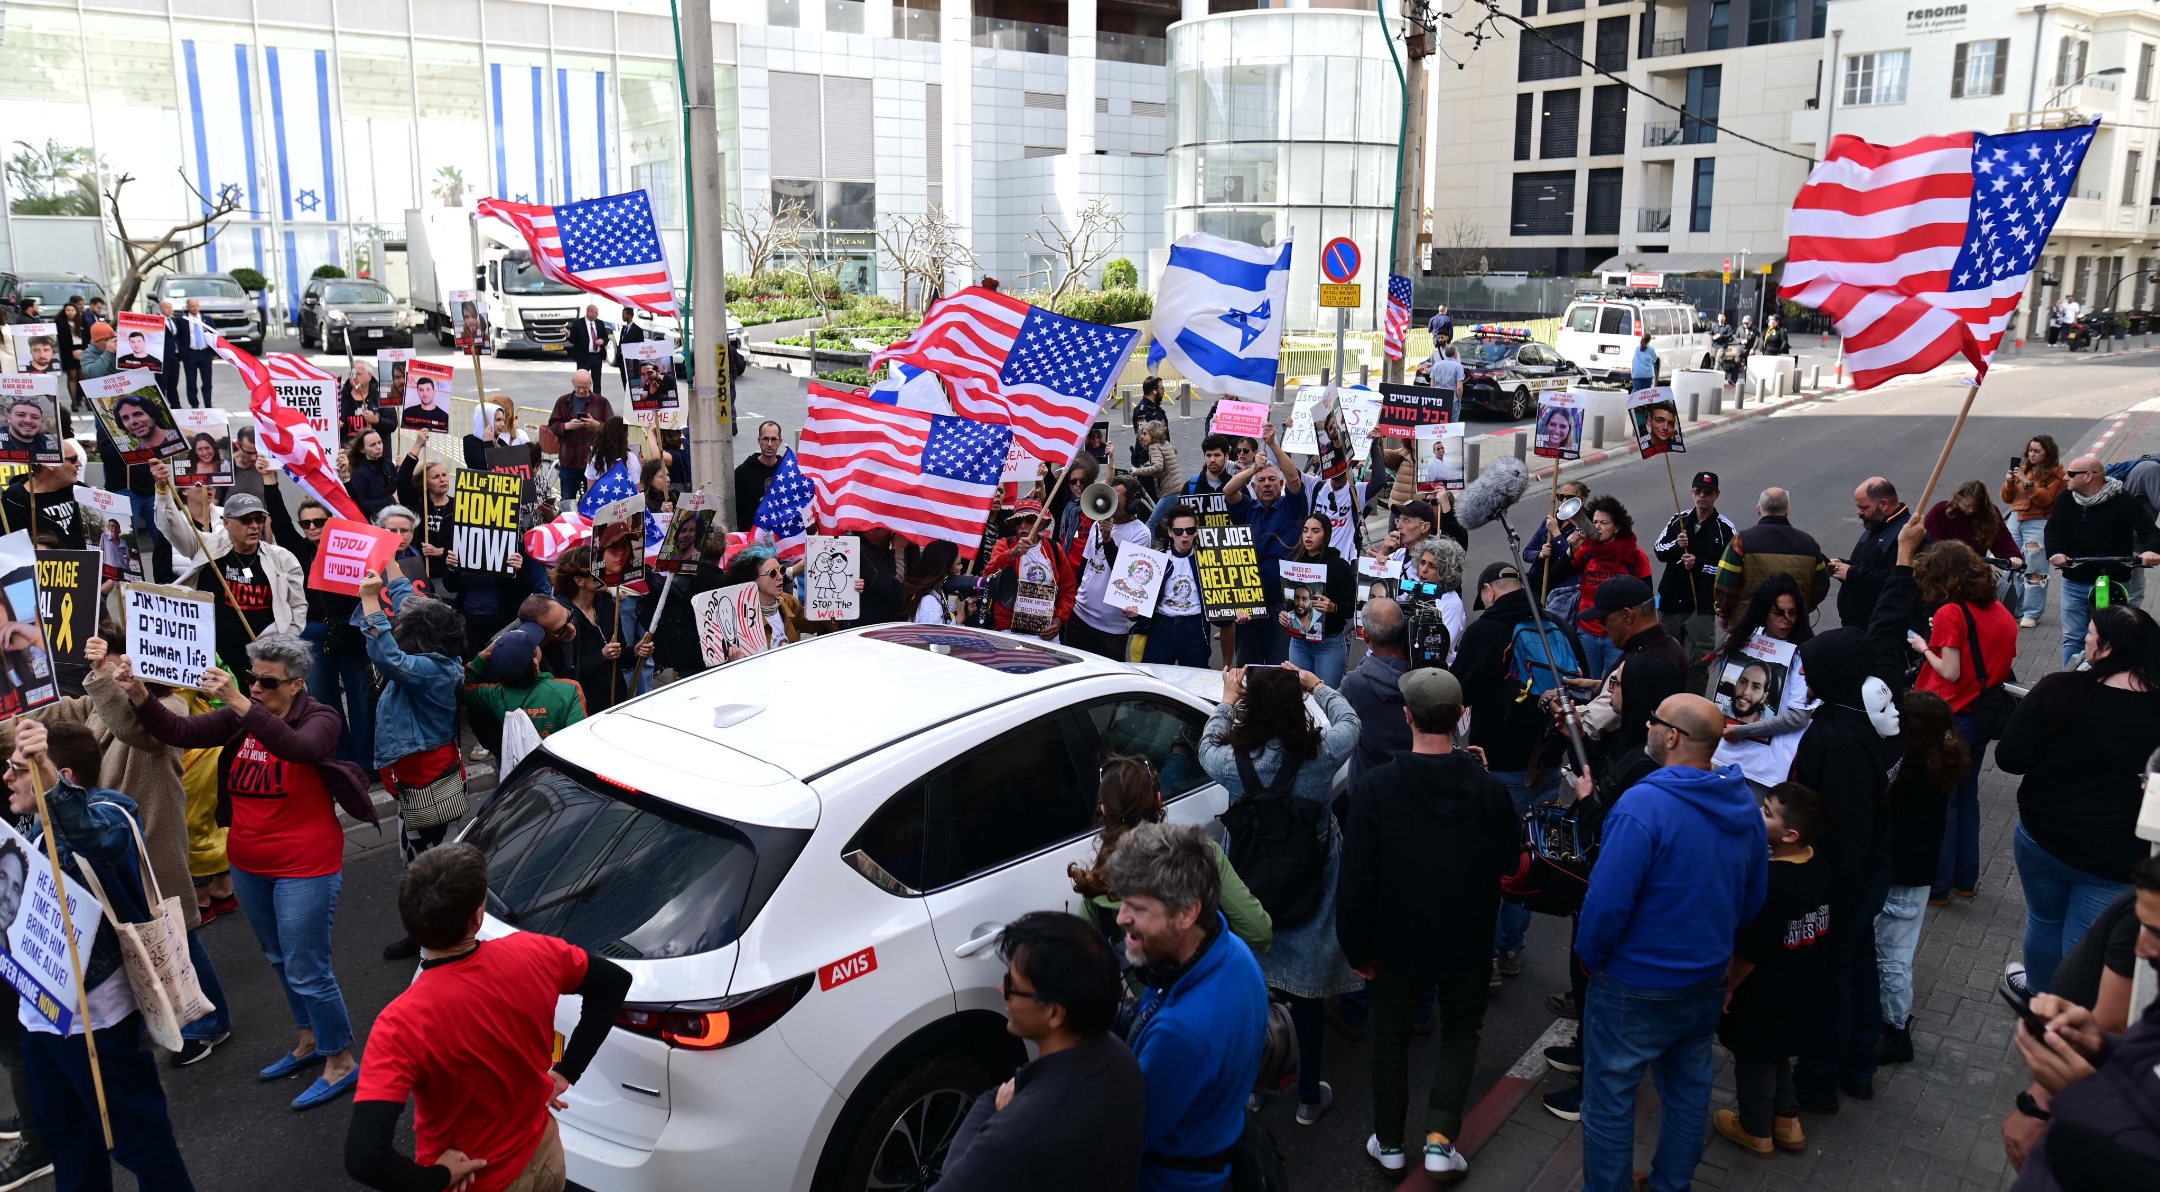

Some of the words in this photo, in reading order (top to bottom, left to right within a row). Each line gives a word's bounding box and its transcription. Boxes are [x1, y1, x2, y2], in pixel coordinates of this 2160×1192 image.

[1907, 4, 1967, 20] renoma
[1931, 18, 1966, 27] Apartments
[275, 386, 322, 395] BRING
[1296, 389, 1322, 402] Israe
[1341, 394, 1359, 404] ust
[1390, 393, 1419, 404] שבויים
[1421, 396, 1443, 407] פדיון
[296, 407, 321, 417] ME
[1382, 405, 1418, 421] מחיר
[1422, 407, 1449, 424] בכל
[1365, 418, 1373, 427] to
[174, 459, 191, 468] BRING
[1323, 461, 1332, 470] HIM
[457, 471, 479, 490] ALL
[479, 475, 487, 487] OF
[488, 474, 521, 495] THEM
[454, 491, 519, 528] HOME
[333, 535, 368, 551] עסקה
[1222, 527, 1253, 547] JOE!
[453, 524, 517, 574] NOW!
[1197, 549, 1220, 567] MR.
[1221, 548, 1257, 566] BIDEN
[328, 562, 360, 578] עכשיו!
[1200, 566, 1238, 588] HELP
[1240, 566, 1261, 587] US
[132, 592, 153, 610] את
[1204, 589, 1232, 604] SAVE
[1232, 587, 1265, 603] THEM!
[156, 595, 199, 619] החזירו
[812, 600, 833, 609] STOP
[1208, 609, 1217, 617] ALL
[1220, 608, 1235, 617] THEM
[1252, 606, 1267, 615] NOW!
[139, 614, 196, 641] החטופים
[140, 638, 182, 664] Human
[187, 646, 207, 668] life
[141, 661, 178, 680] comes
[524, 707, 547, 717] spa
[37, 870, 49, 892] HE
[48, 882, 61, 905] HA
[32, 891, 51, 919] TIME
[51, 907, 60, 929] TO
[25, 913, 49, 944] BRING
[48, 935, 65, 960] HIM
[21, 934, 43, 966] HOME
[42, 954, 68, 989] ALIVE!
[831, 954, 869, 984] AVIS
[16, 973, 38, 1005] HOME
[37, 992, 60, 1024] NOW!
